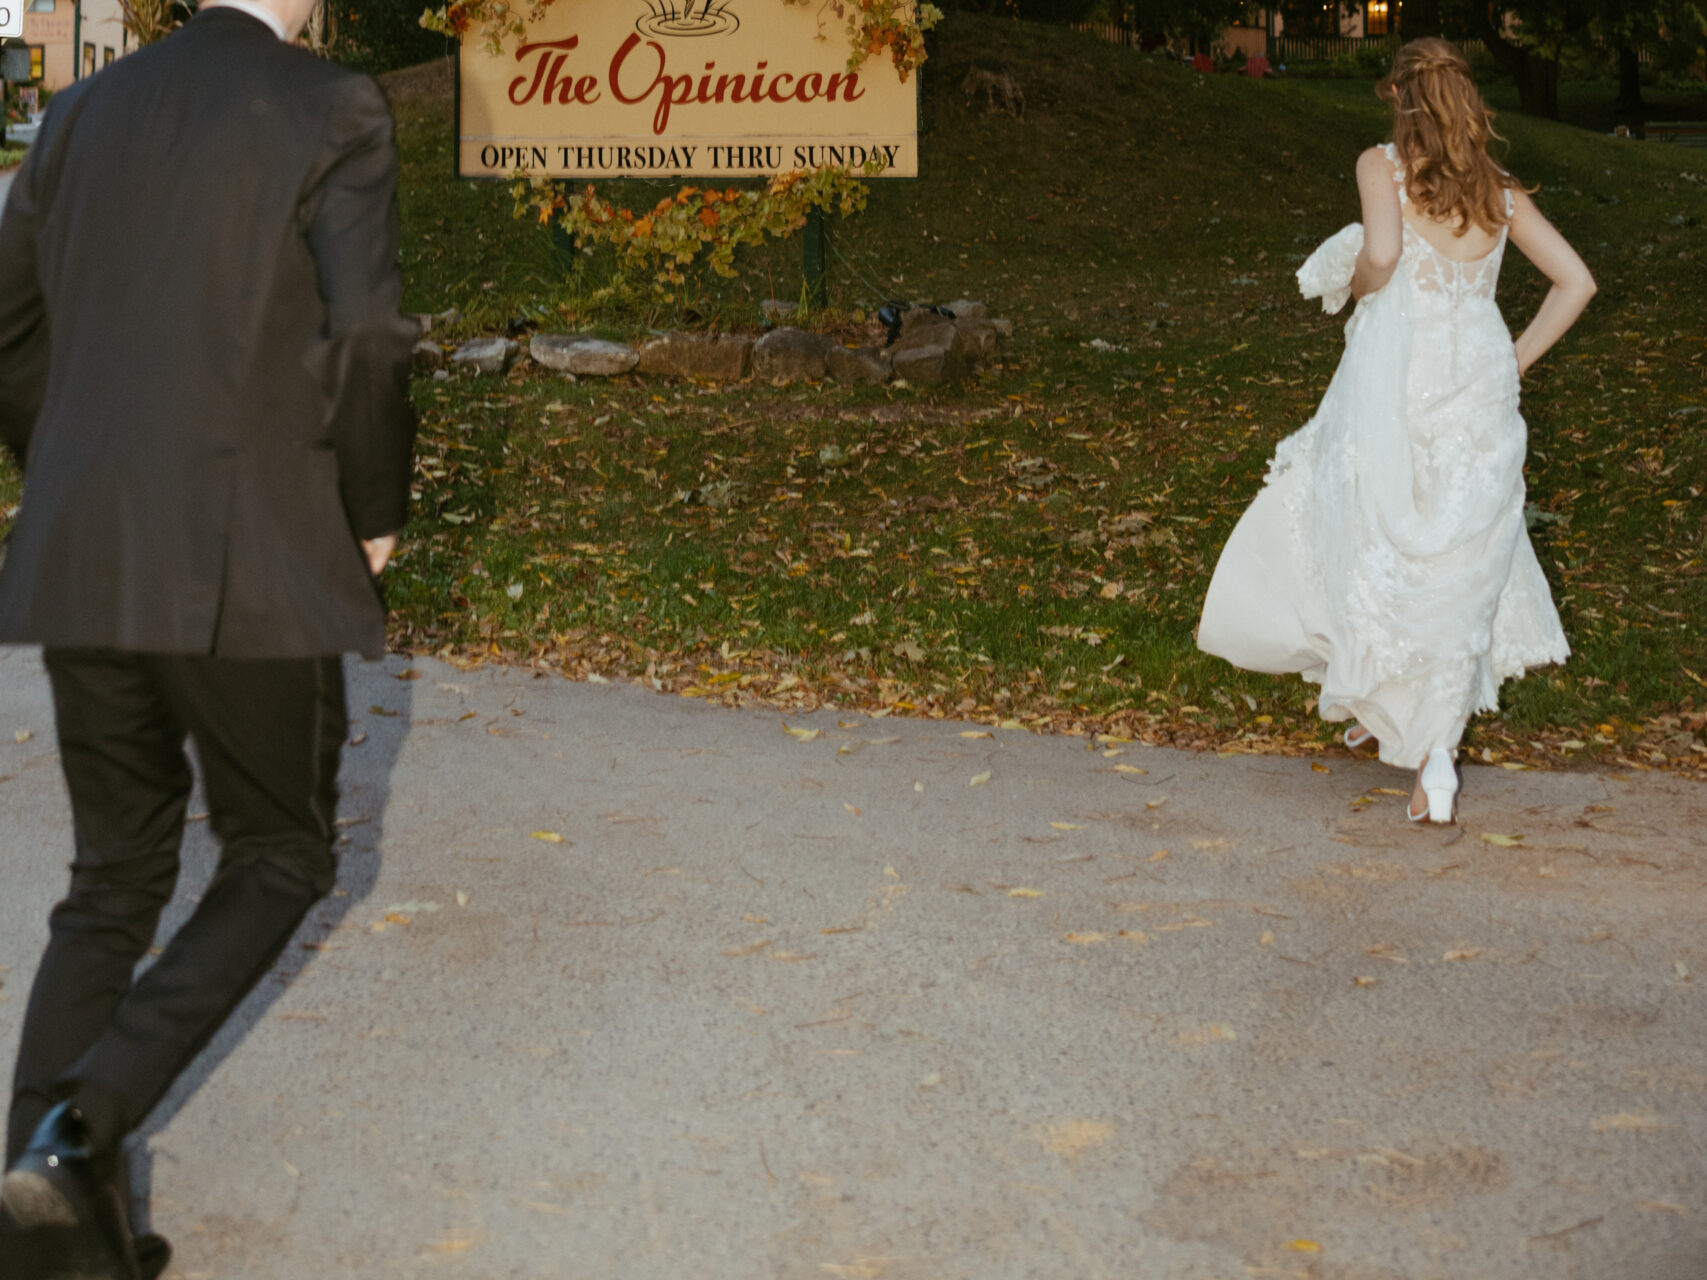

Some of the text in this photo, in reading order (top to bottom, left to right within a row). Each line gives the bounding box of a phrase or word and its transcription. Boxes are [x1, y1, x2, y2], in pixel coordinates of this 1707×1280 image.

[508, 32, 865, 135] The Opinicon
[481, 144, 899, 169] OPEN THURSDAY THRU SUNDAY
